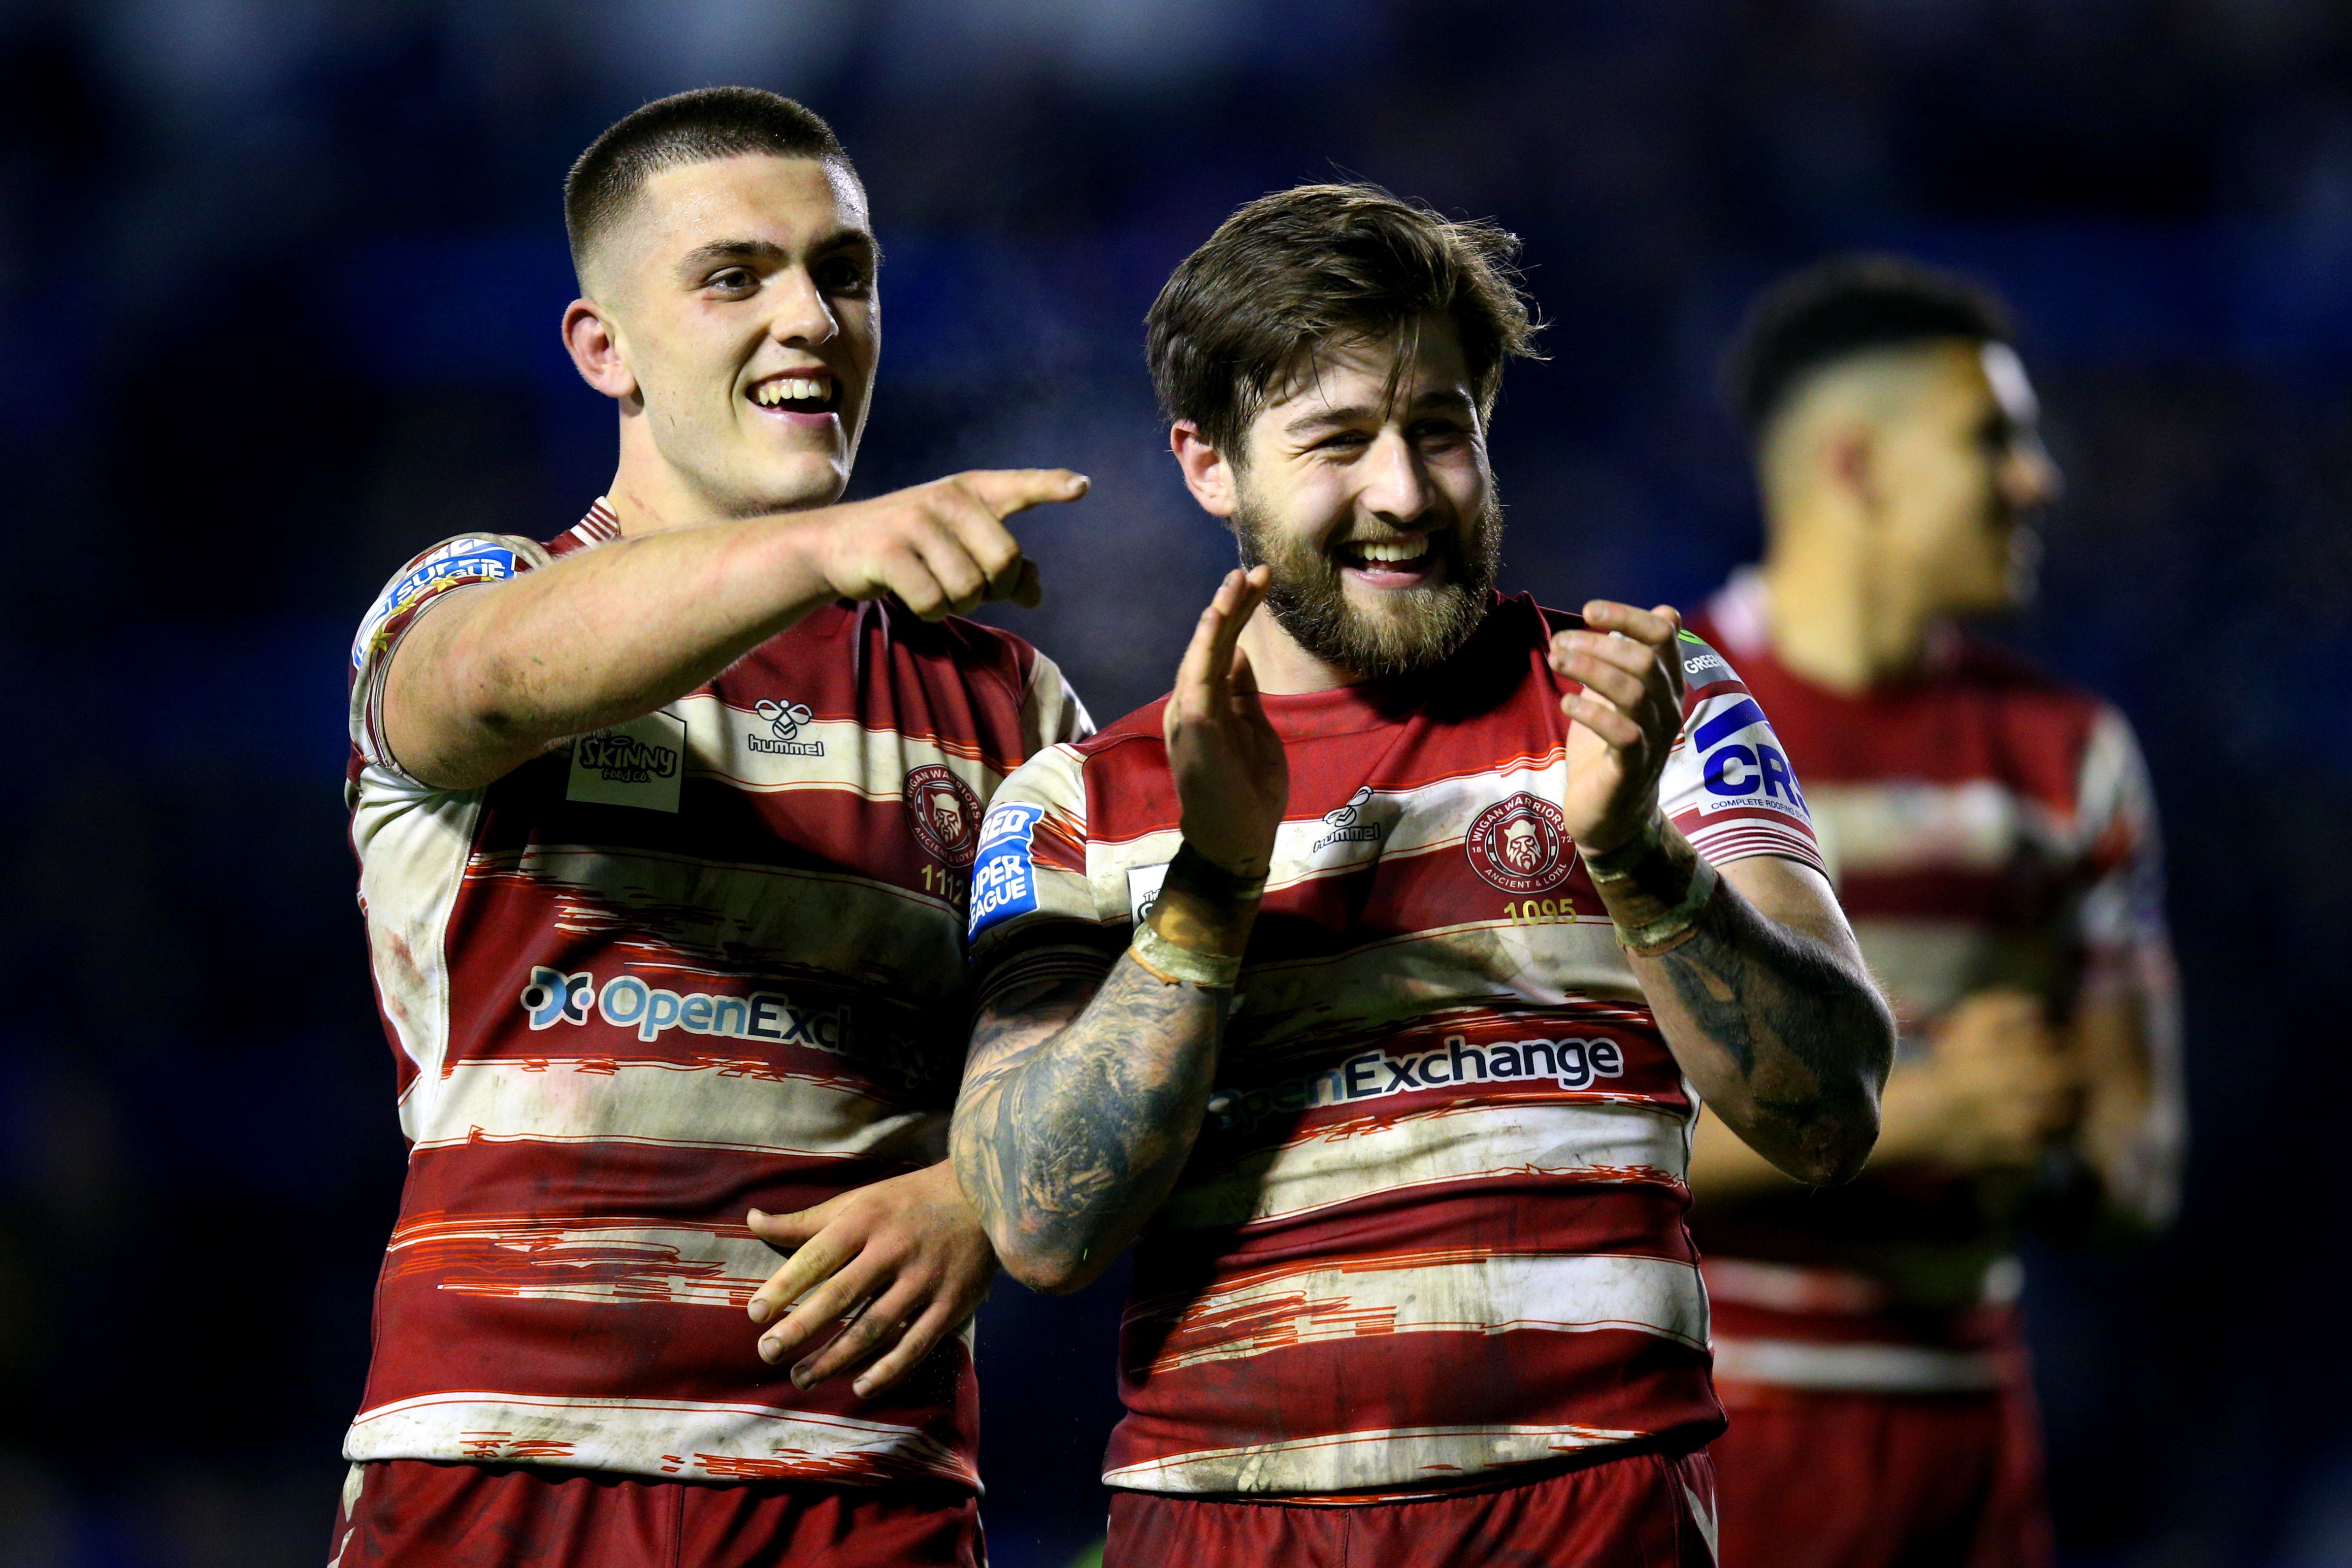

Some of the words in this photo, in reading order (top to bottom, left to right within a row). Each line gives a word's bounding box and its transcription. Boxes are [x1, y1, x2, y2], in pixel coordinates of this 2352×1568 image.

[581, 738, 676, 777] SKINNY
[749, 734, 824, 756] hummel
[906, 771, 929, 798] WIGAN
[929, 769, 981, 819] WARIORS
[1710, 798, 1764, 810] COMPLETE
[1766, 799, 1795, 815] ROOFING
[1471, 808, 1503, 842] WIGAN
[1504, 796, 1566, 832] WARRIORS
[1313, 822, 1379, 853] hummel
[1561, 835, 1572, 844] 72
[954, 846, 975, 863] LOYA
[921, 863, 965, 906] 1112
[970, 855, 1025, 906] UPER
[1484, 868, 1531, 888] ANCIENT
[1544, 862, 1567, 884] LOYAL
[1503, 898, 1577, 927] 1095
